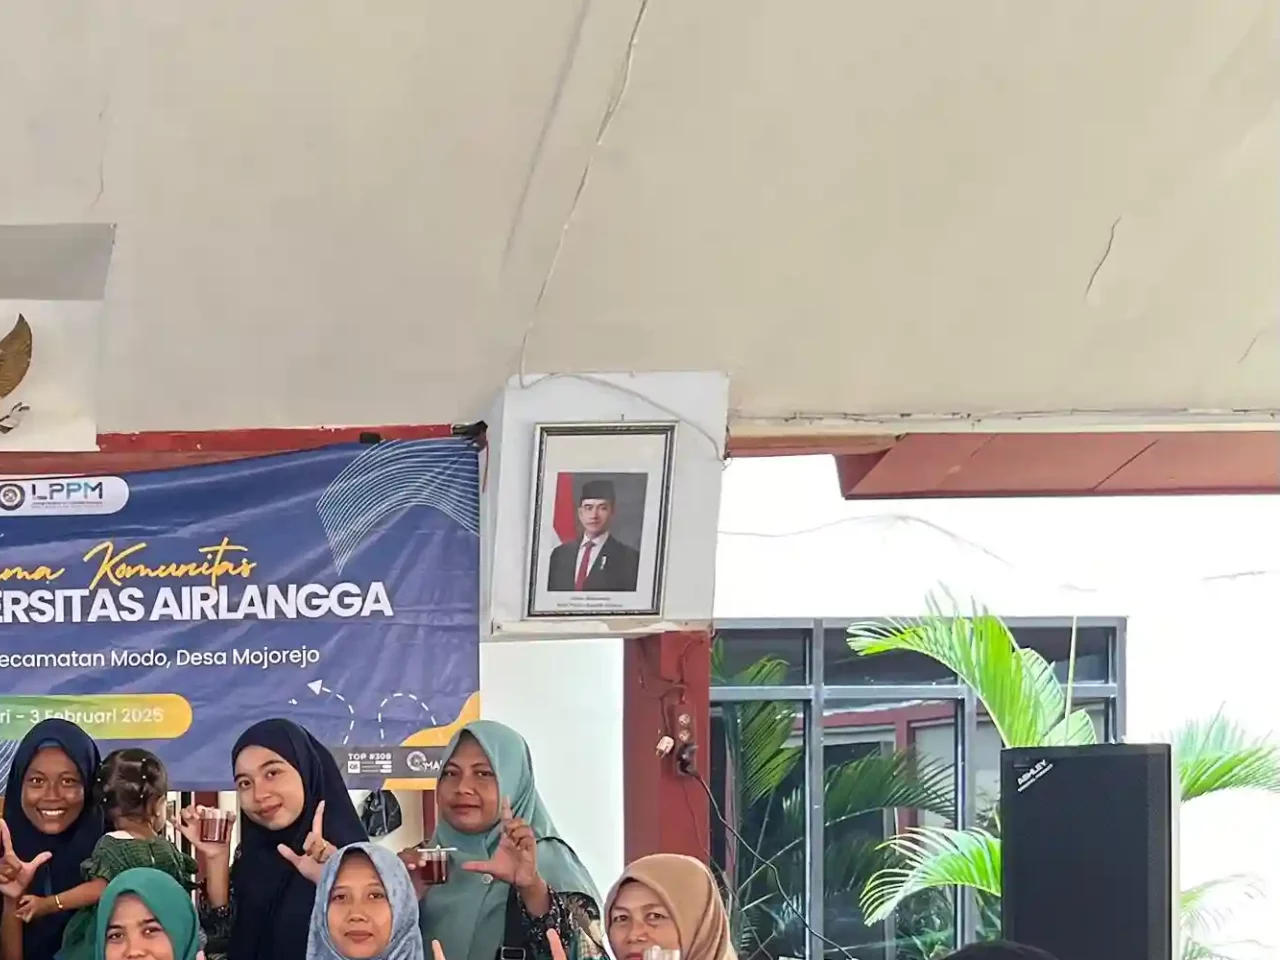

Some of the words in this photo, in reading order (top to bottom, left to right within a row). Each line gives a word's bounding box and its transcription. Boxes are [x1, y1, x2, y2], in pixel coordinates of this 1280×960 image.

[32, 481, 103, 500] LPPM
[83, 537, 257, 590] Komunitas
[149, 581, 395, 621] AIRLANGGA
[110, 650, 172, 670] Modo,
[176, 650, 228, 667] Desa
[232, 645, 321, 669] Mojorejo
[29, 709, 39, 725] 3
[44, 708, 117, 725] Februari
[121, 707, 165, 724] 2025
